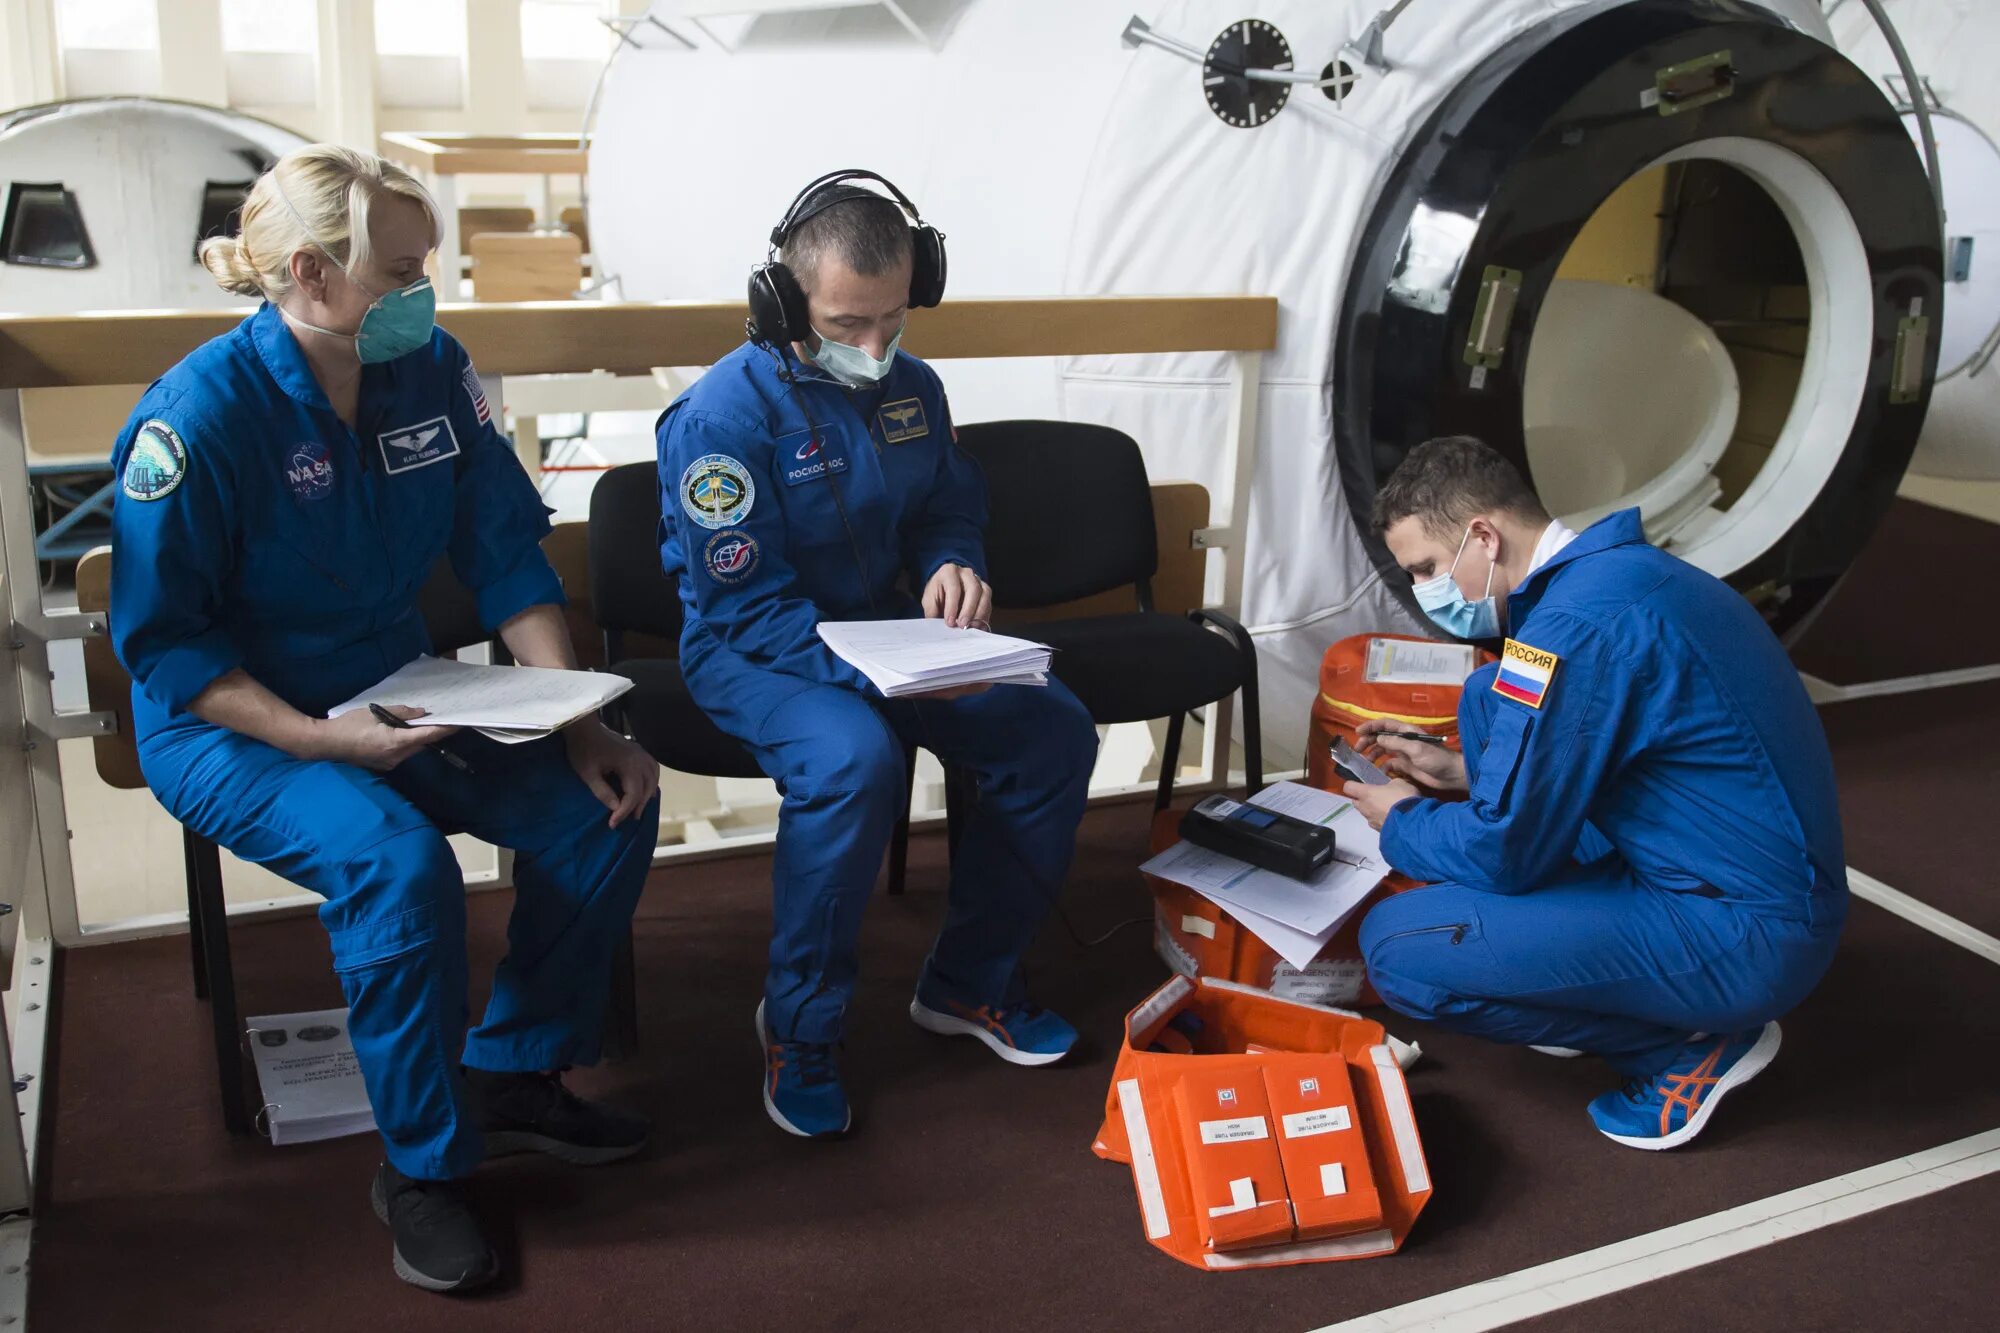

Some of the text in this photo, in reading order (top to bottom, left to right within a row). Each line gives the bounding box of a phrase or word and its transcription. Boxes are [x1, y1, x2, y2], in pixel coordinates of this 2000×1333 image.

[403, 455, 418, 463] KATE
[287, 460, 333, 483] NASA
[1506, 642, 1553, 669] РОССИЯ
